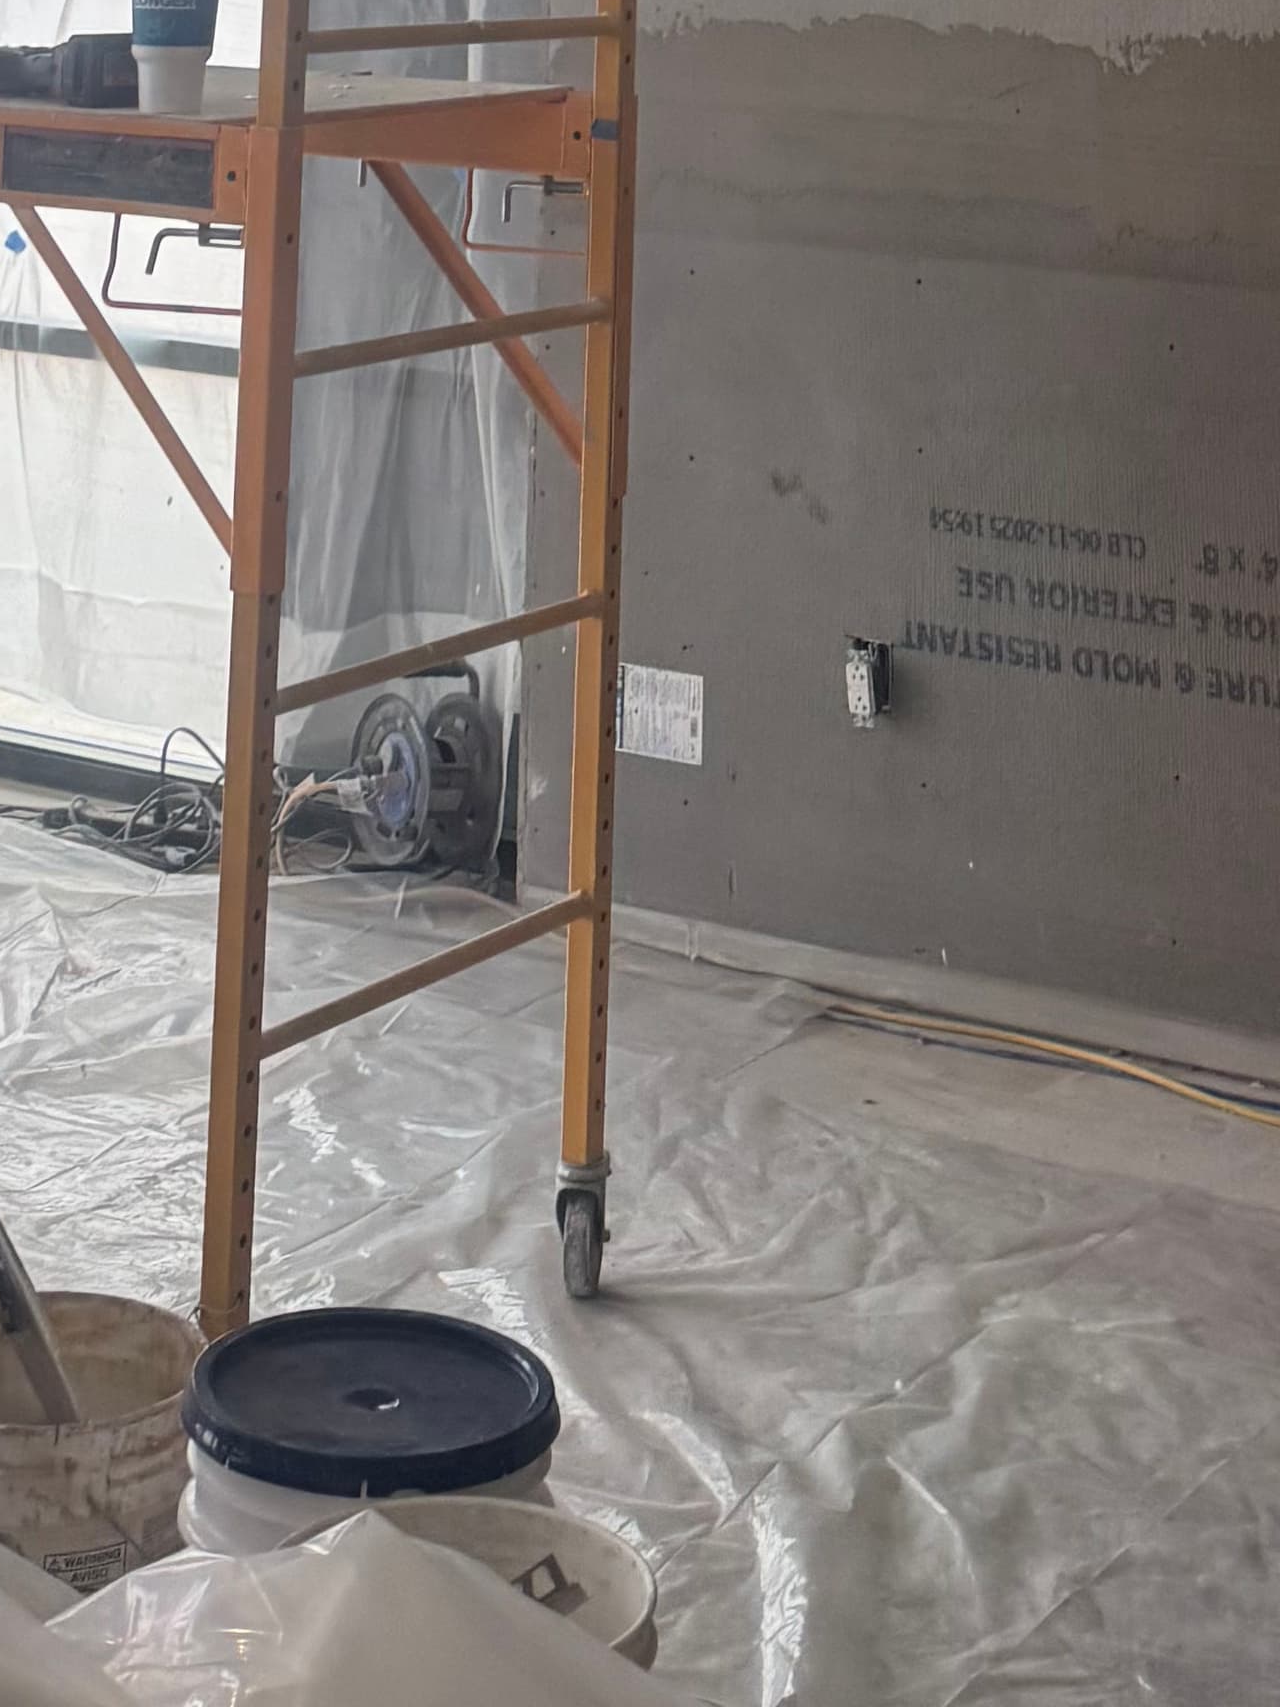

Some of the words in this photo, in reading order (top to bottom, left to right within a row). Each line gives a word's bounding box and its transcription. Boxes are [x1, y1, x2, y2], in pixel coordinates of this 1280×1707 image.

[1106, 531, 1147, 561] CLB
[954, 566, 1016, 606] USE
[1025, 575, 1178, 630] EXTERIOR
[1188, 601, 1213, 634] &
[900, 619, 1063, 674] RESISTANT
[1071, 645, 1163, 691] MOLD
[1174, 661, 1197, 695] &
[64, 1547, 122, 1568] WARNING
[70, 1568, 109, 1583] AVISO
